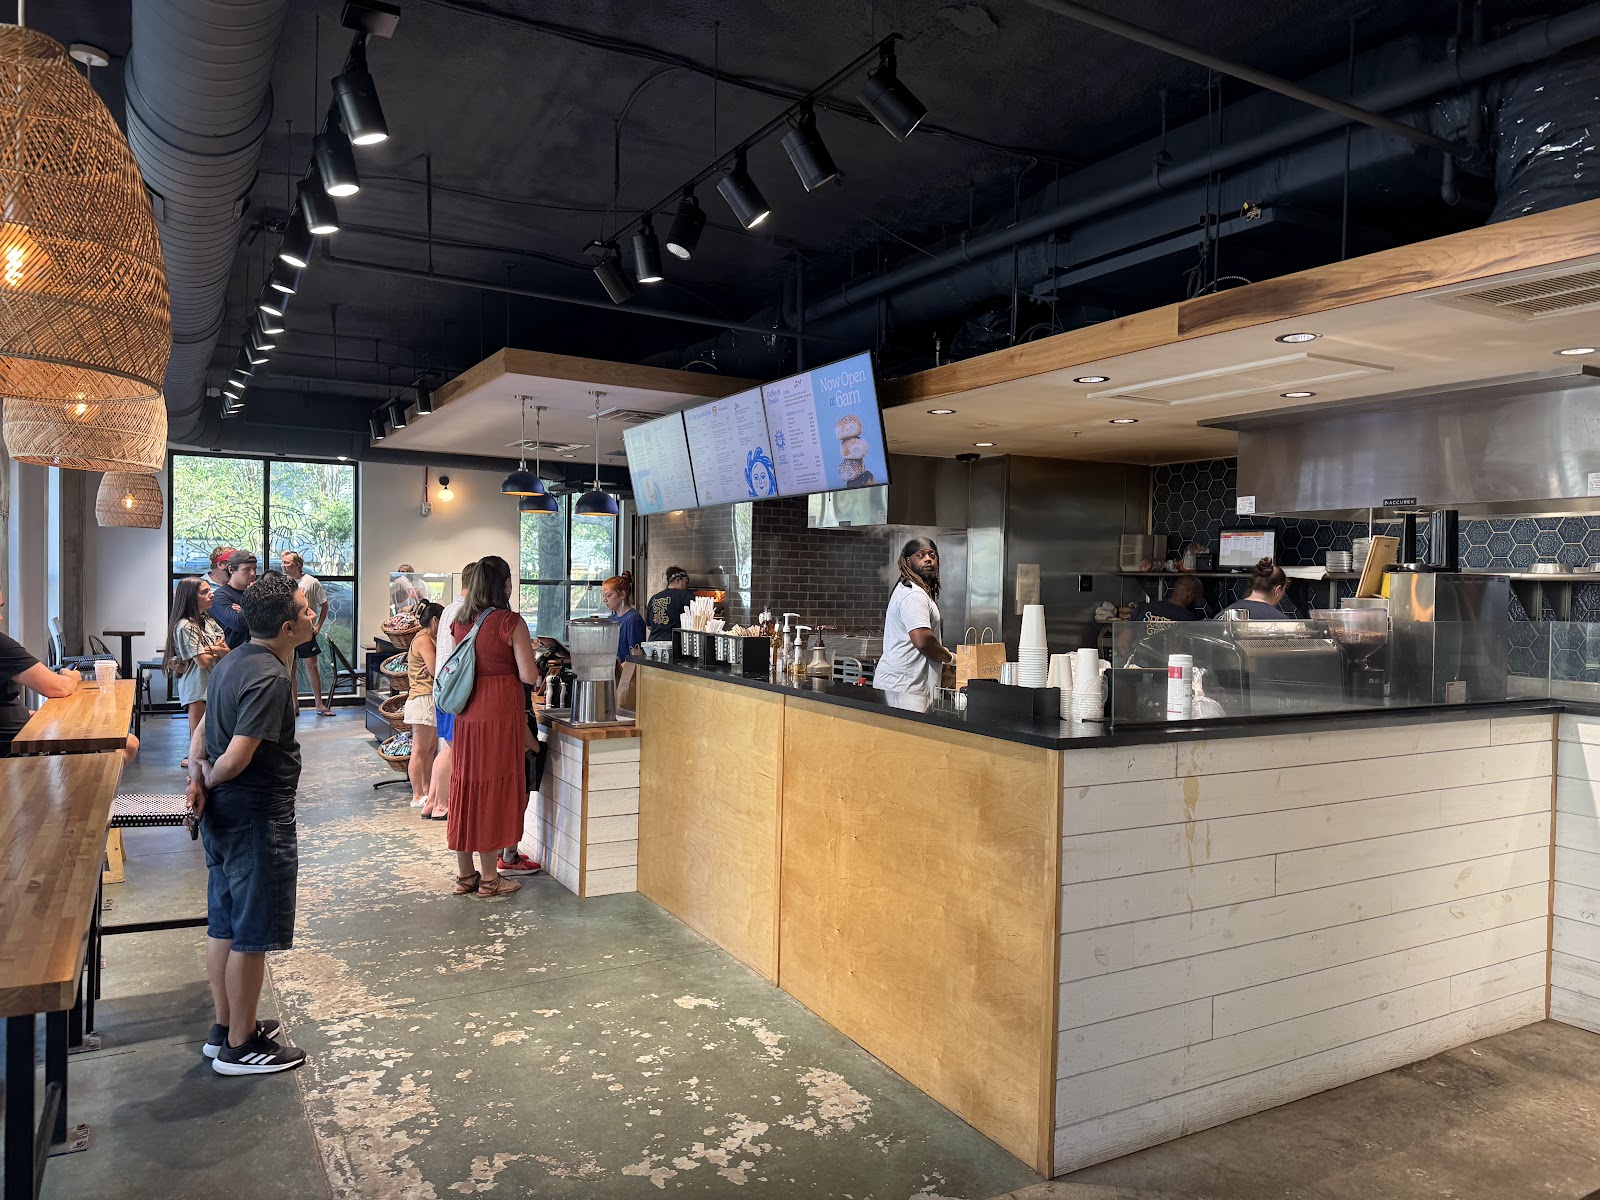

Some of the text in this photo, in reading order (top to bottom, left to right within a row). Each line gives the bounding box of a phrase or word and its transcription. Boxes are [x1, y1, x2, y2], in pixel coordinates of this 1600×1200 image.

[820, 370, 866, 392] Now Open
[830, 390, 861, 408] at 6am
